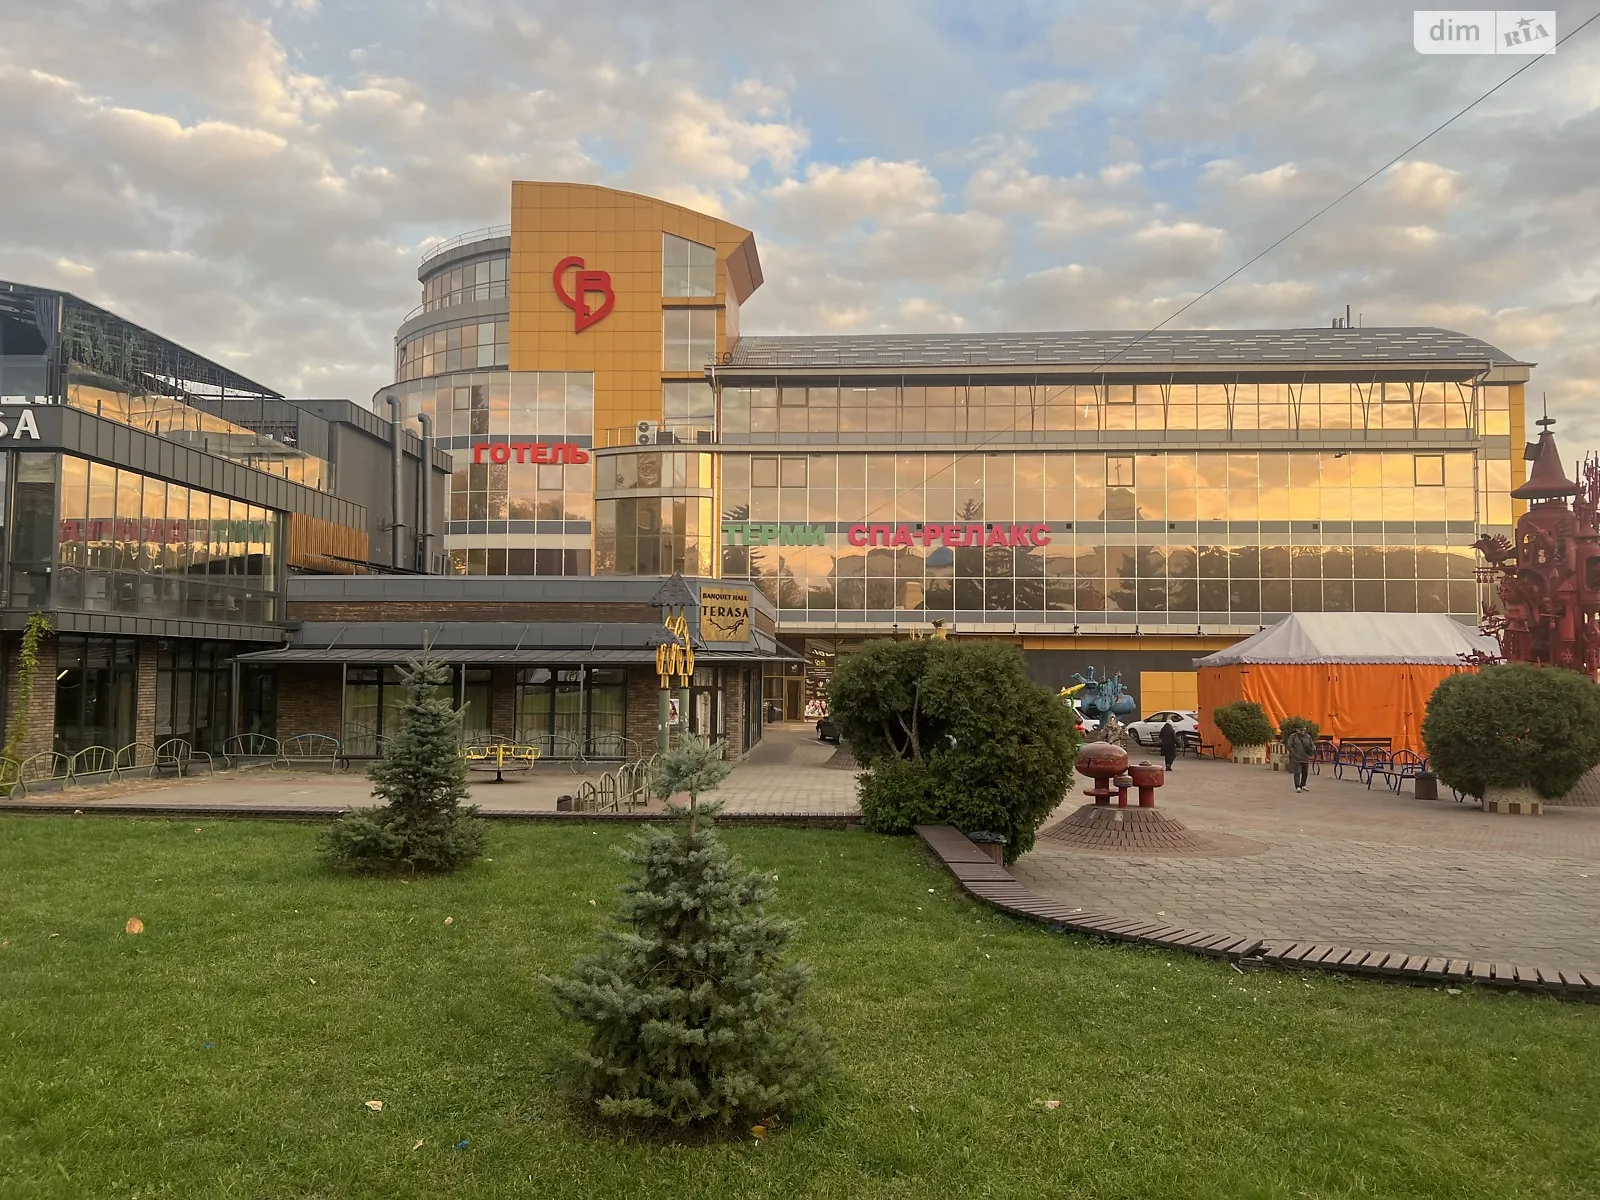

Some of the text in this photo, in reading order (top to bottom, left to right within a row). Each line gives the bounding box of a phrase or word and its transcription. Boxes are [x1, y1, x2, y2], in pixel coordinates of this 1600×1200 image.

[473, 442, 590, 465] ГОТЕЛЬ
[721, 523, 1051, 547] ТЕРМИ СПА-РЕЛАКС
[702, 592, 749, 602] BANQUET HALL
[701, 605, 749, 618] TERASA
